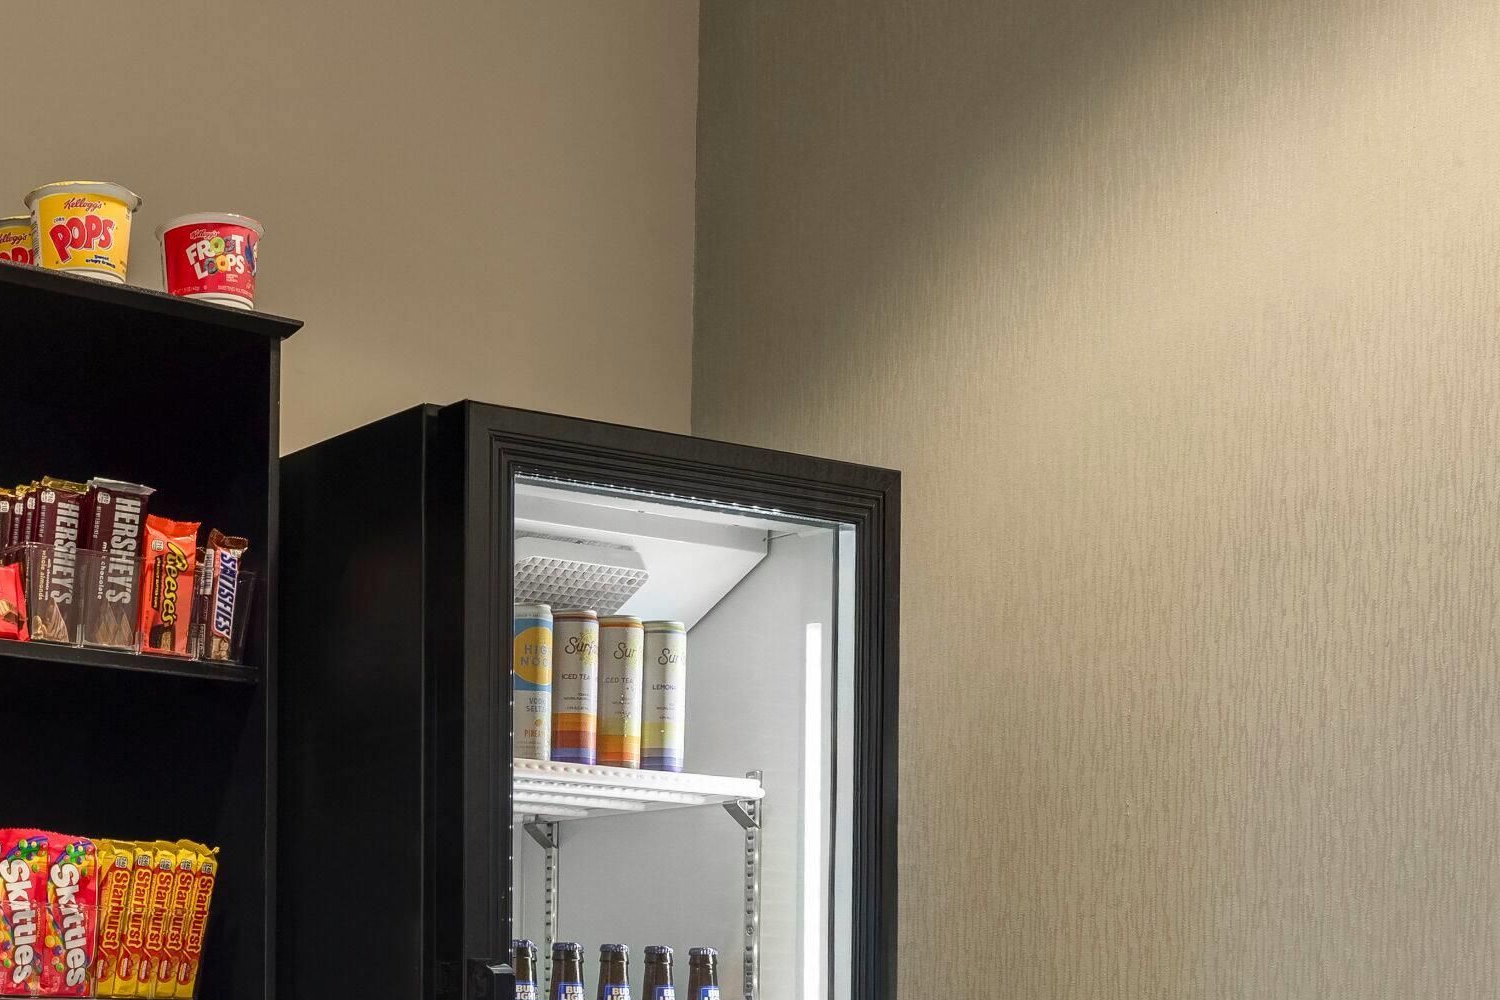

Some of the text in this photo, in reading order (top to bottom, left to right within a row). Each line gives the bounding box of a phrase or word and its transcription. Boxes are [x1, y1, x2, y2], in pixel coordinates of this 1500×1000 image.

[49, 215, 114, 263] POPS
[64, 198, 103, 211] Kellogg's
[186, 236, 244, 265] FROOT
[192, 256, 245, 280] LOOPS
[51, 502, 79, 605] HERSHEY'S
[106, 497, 141, 604] HERSHEY'S
[162, 542, 188, 626] Reese's
[214, 550, 238, 634] SATISFIES
[524, 644, 547, 654] HIG
[0, 860, 34, 984] Skittles
[50, 863, 86, 987] Skittles
[102, 870, 131, 950] Starburst
[127, 869, 152, 948] Starburst
[146, 872, 173, 950] Starburst
[166, 872, 194, 950] Starburst
[187, 875, 214, 952] Starburst
